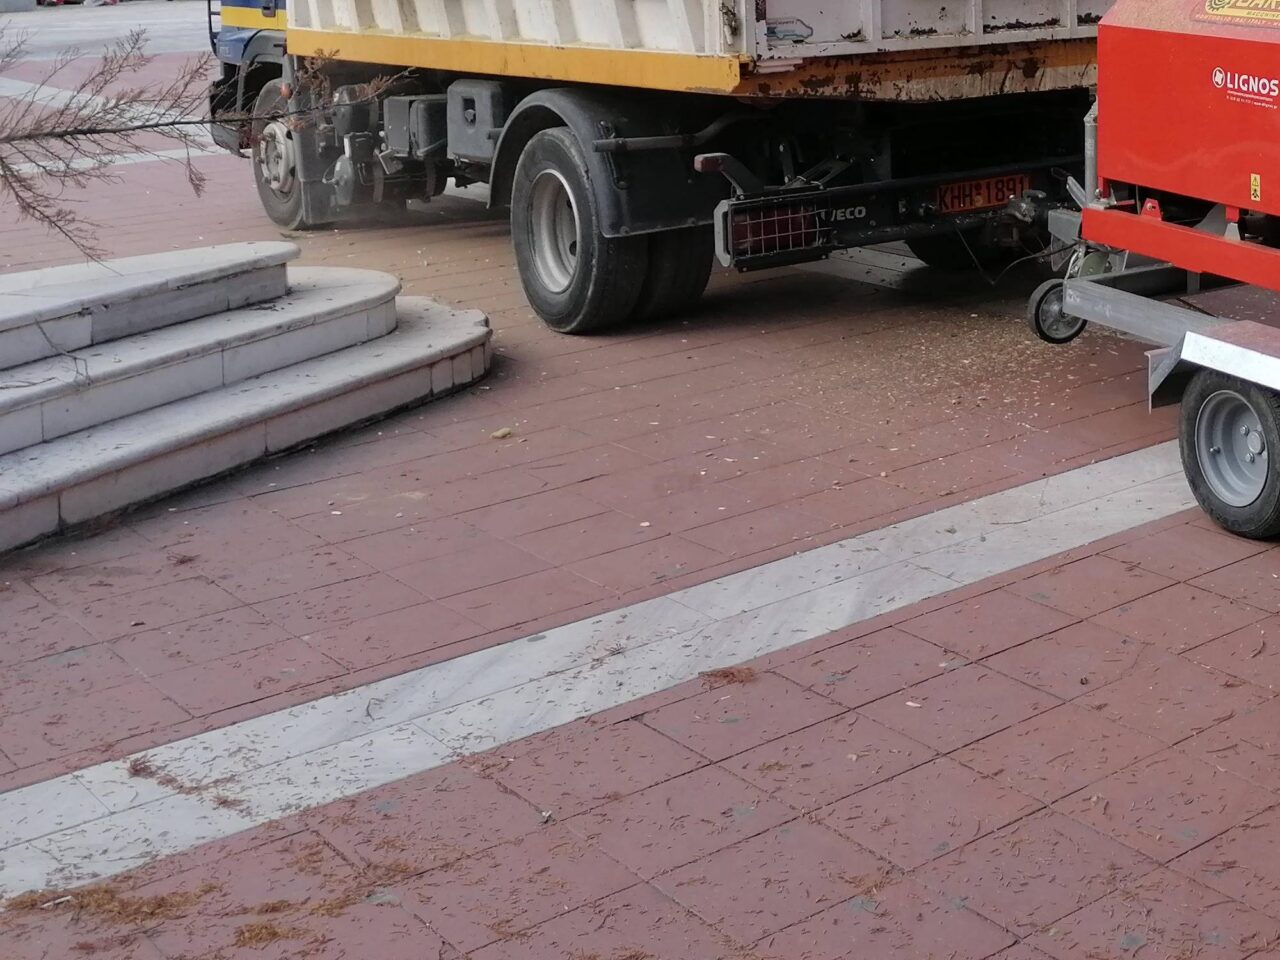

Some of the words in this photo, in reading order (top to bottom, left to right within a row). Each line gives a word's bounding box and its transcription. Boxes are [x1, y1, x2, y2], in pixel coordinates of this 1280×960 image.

[1226, 71, 1279, 97] LIGNOS
[938, 183, 973, 210] KHH
[986, 177, 1025, 204] 1891
